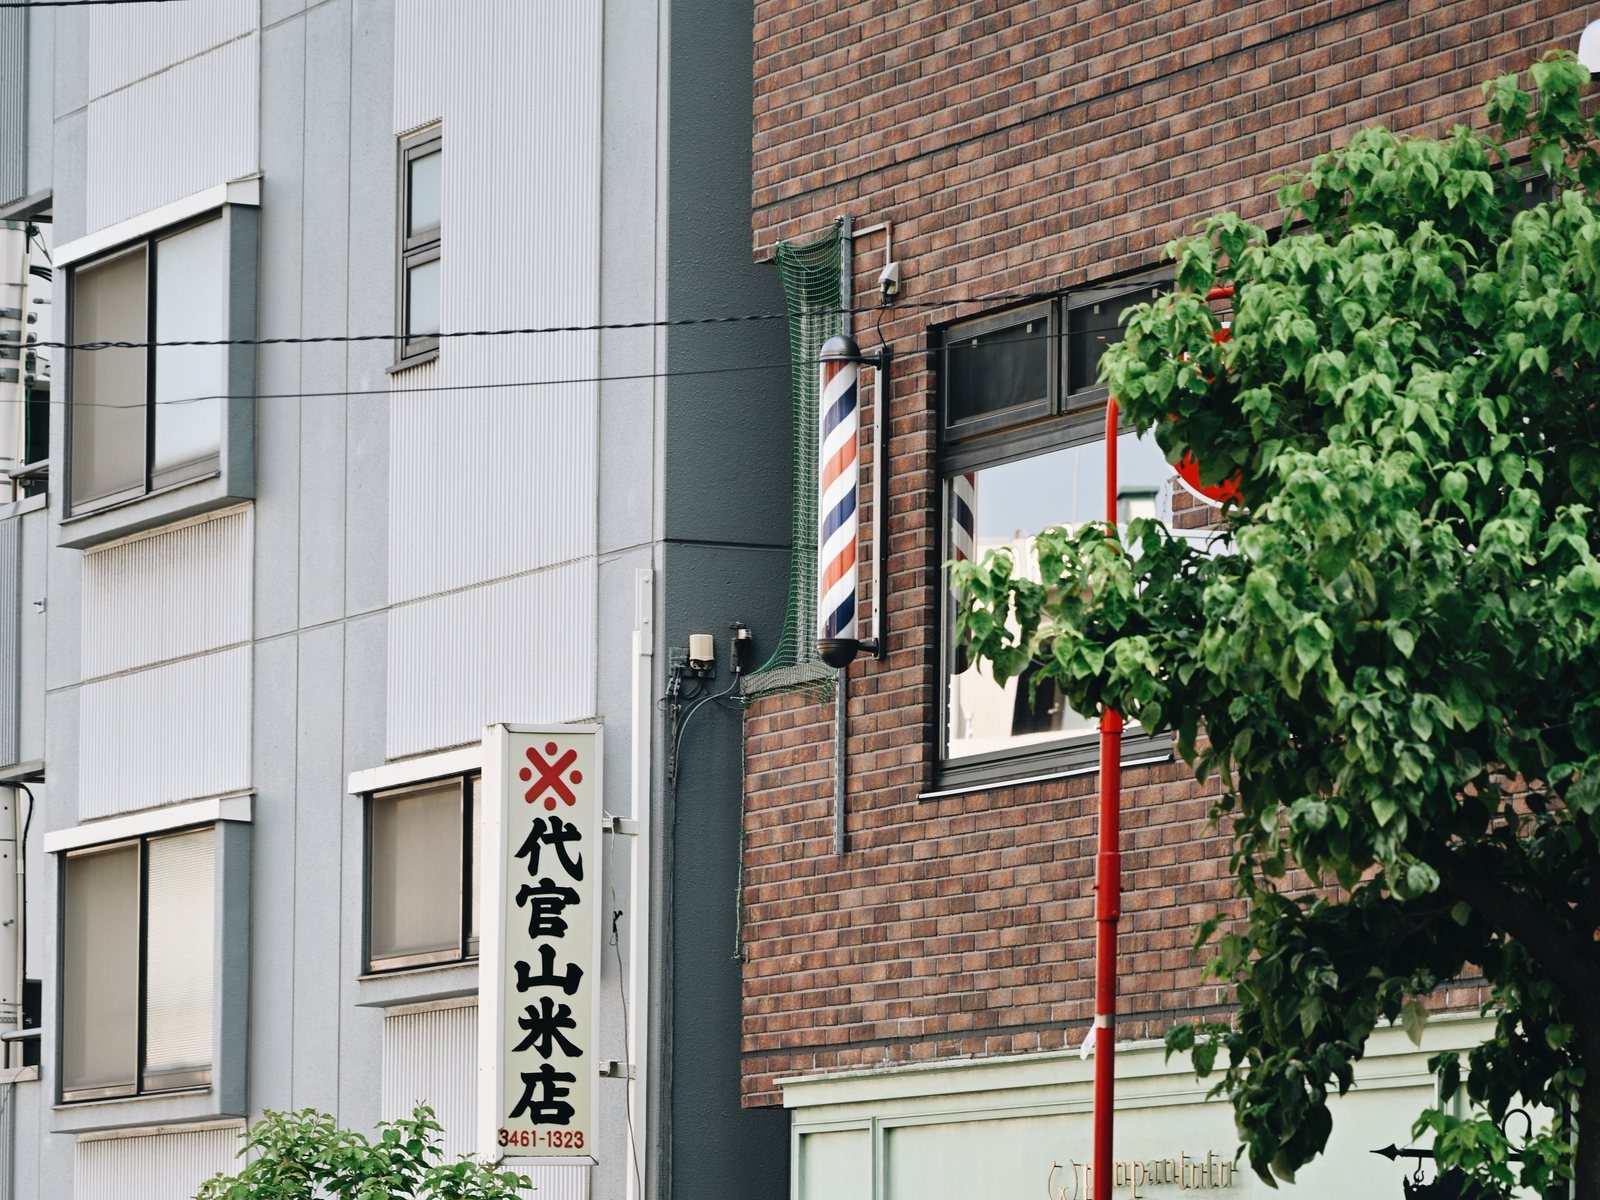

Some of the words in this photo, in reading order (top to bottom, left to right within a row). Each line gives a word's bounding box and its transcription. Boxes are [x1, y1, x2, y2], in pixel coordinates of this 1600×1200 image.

[509, 815, 584, 1126] 代官山米店
[498, 1129, 584, 1149] 3461-1323
